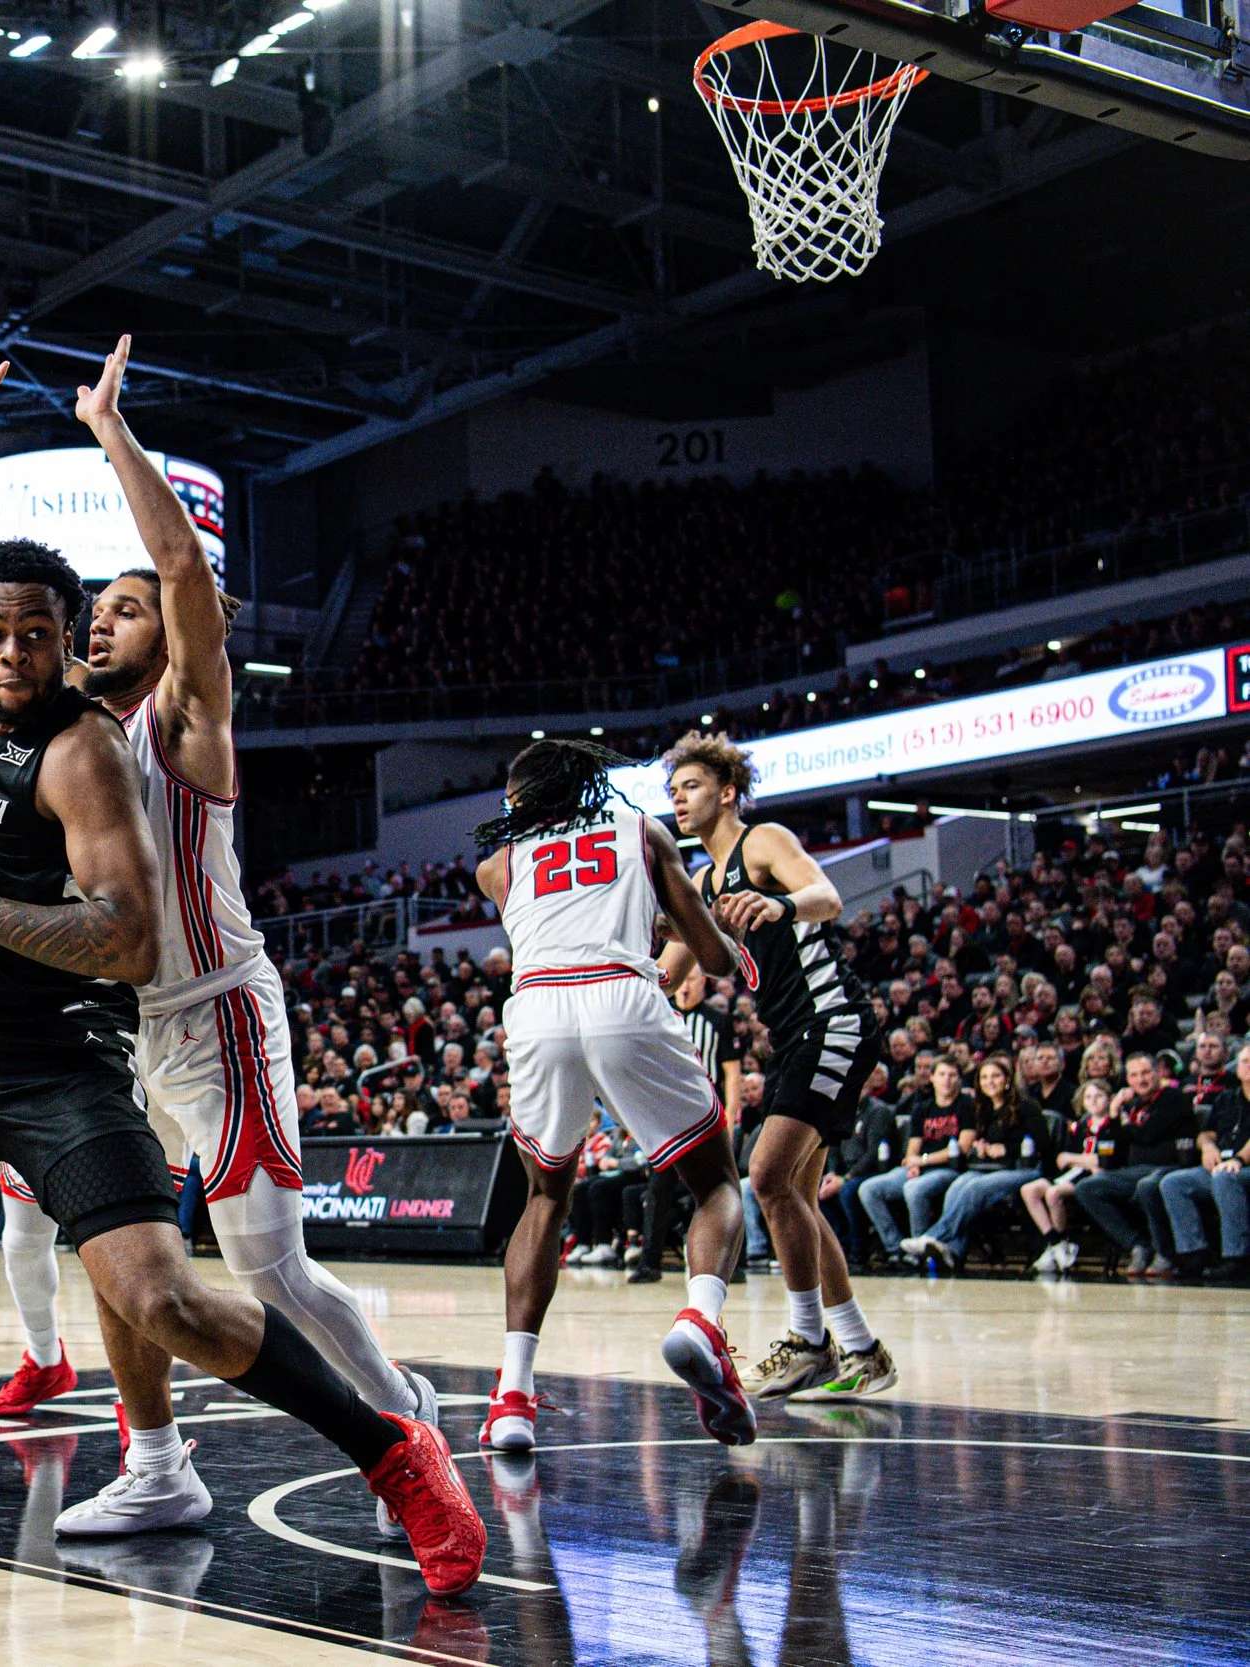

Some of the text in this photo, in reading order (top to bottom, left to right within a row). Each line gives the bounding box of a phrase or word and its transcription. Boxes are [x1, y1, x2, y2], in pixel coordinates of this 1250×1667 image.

[656, 429, 724, 466] 201
[785, 734, 894, 777] Business!
[902, 720, 964, 755] (513)
[973, 695, 1095, 739] 531-6900
[532, 830, 619, 900] 25
[390, 1199, 454, 1219] LINDNER
